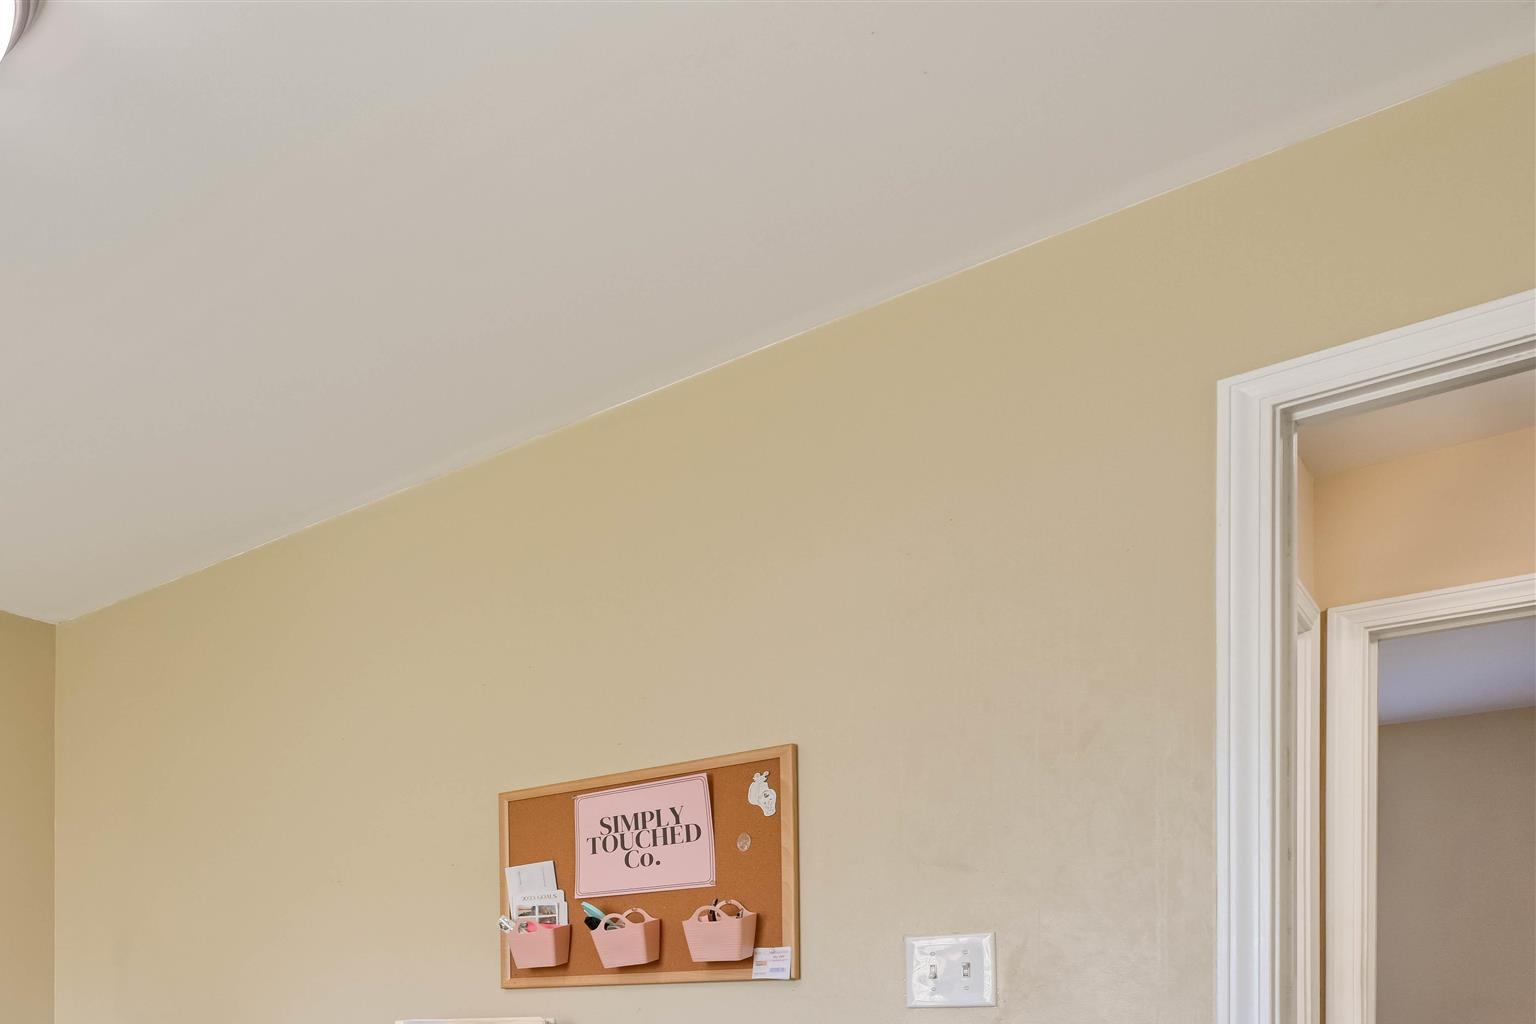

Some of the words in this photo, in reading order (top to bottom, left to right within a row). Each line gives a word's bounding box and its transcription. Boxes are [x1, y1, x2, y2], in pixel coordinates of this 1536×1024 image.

[599, 805, 684, 836] SIMPLY
[586, 823, 702, 856] TOUCHED
[624, 849, 661, 869] Co.
